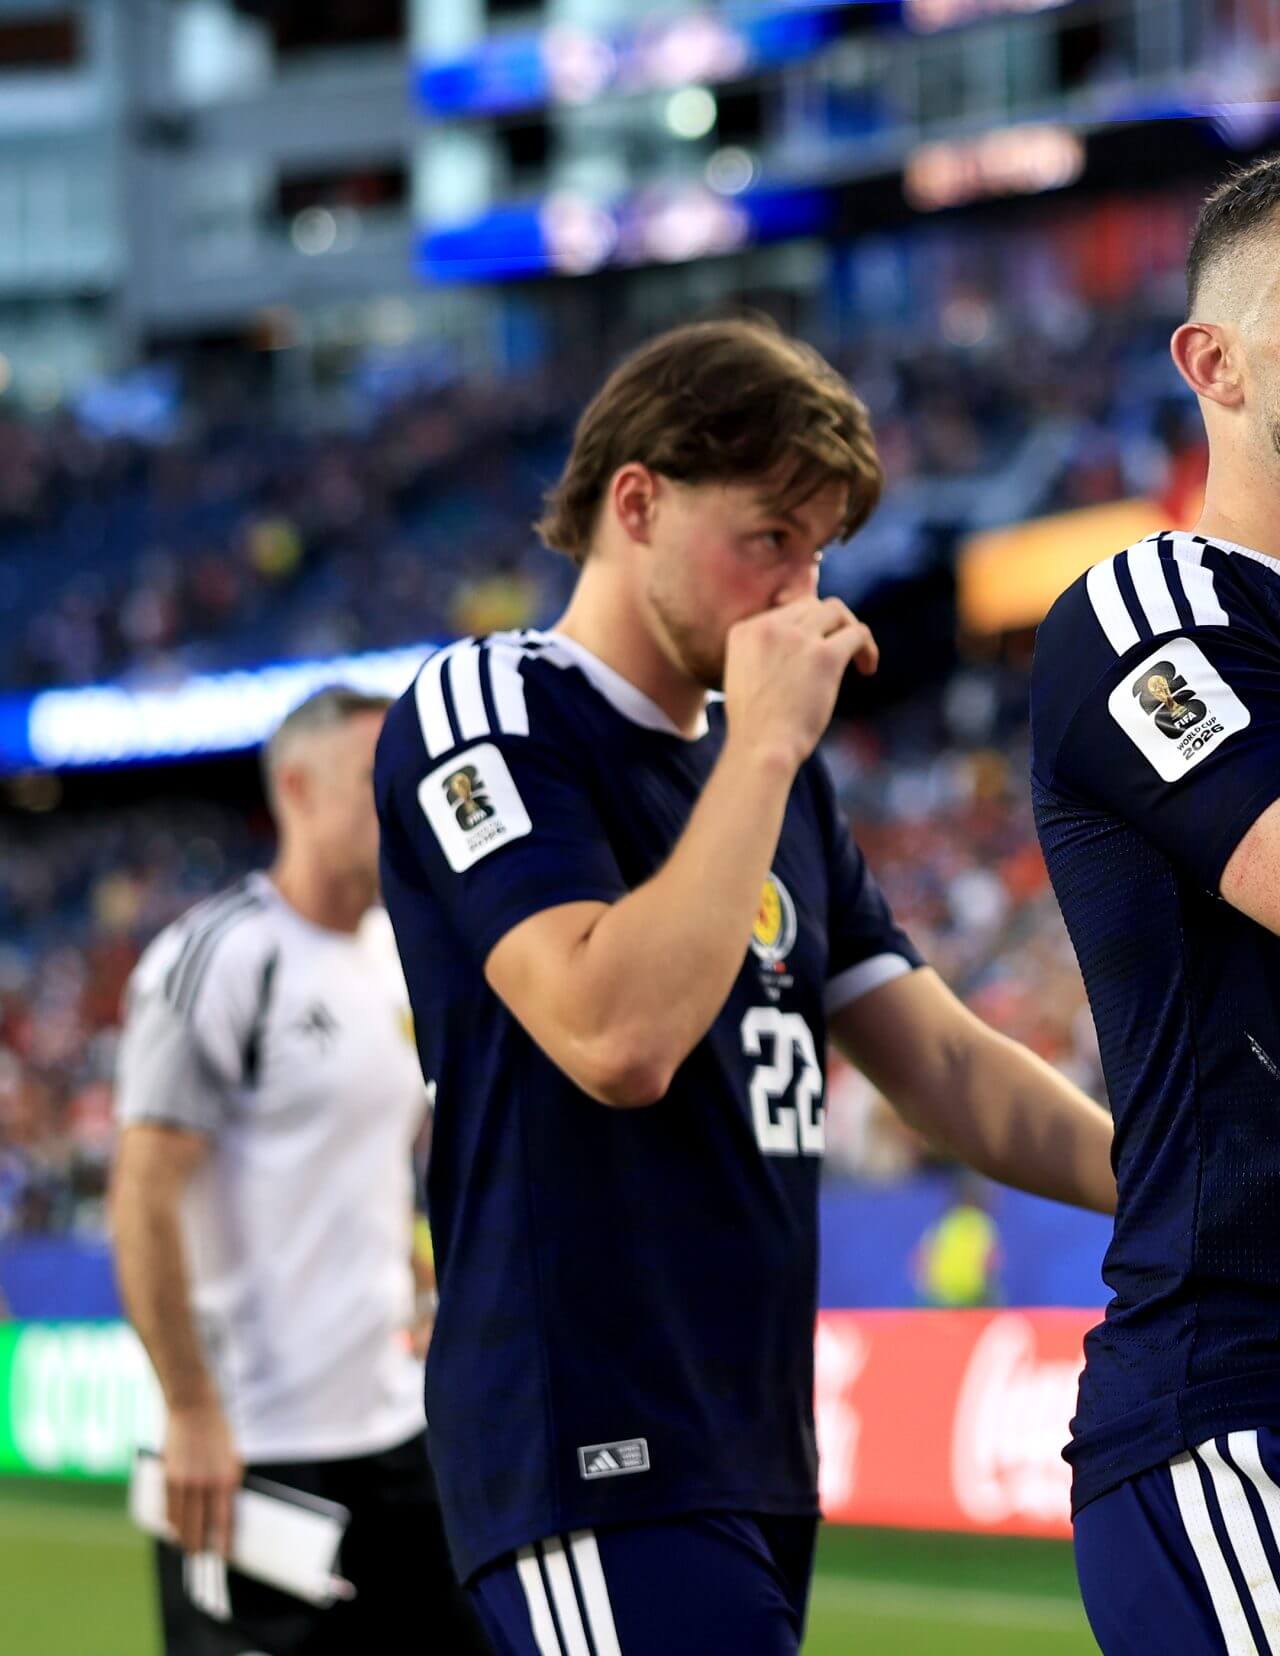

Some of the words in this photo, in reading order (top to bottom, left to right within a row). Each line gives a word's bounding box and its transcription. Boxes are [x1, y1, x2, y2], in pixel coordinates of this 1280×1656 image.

[1173, 711, 1197, 729] FIFA
[1177, 726, 1201, 750] WORLD
[1201, 716, 1217, 729] CUP
[1182, 723, 1225, 761] 2026
[740, 1005, 826, 1156] 22
